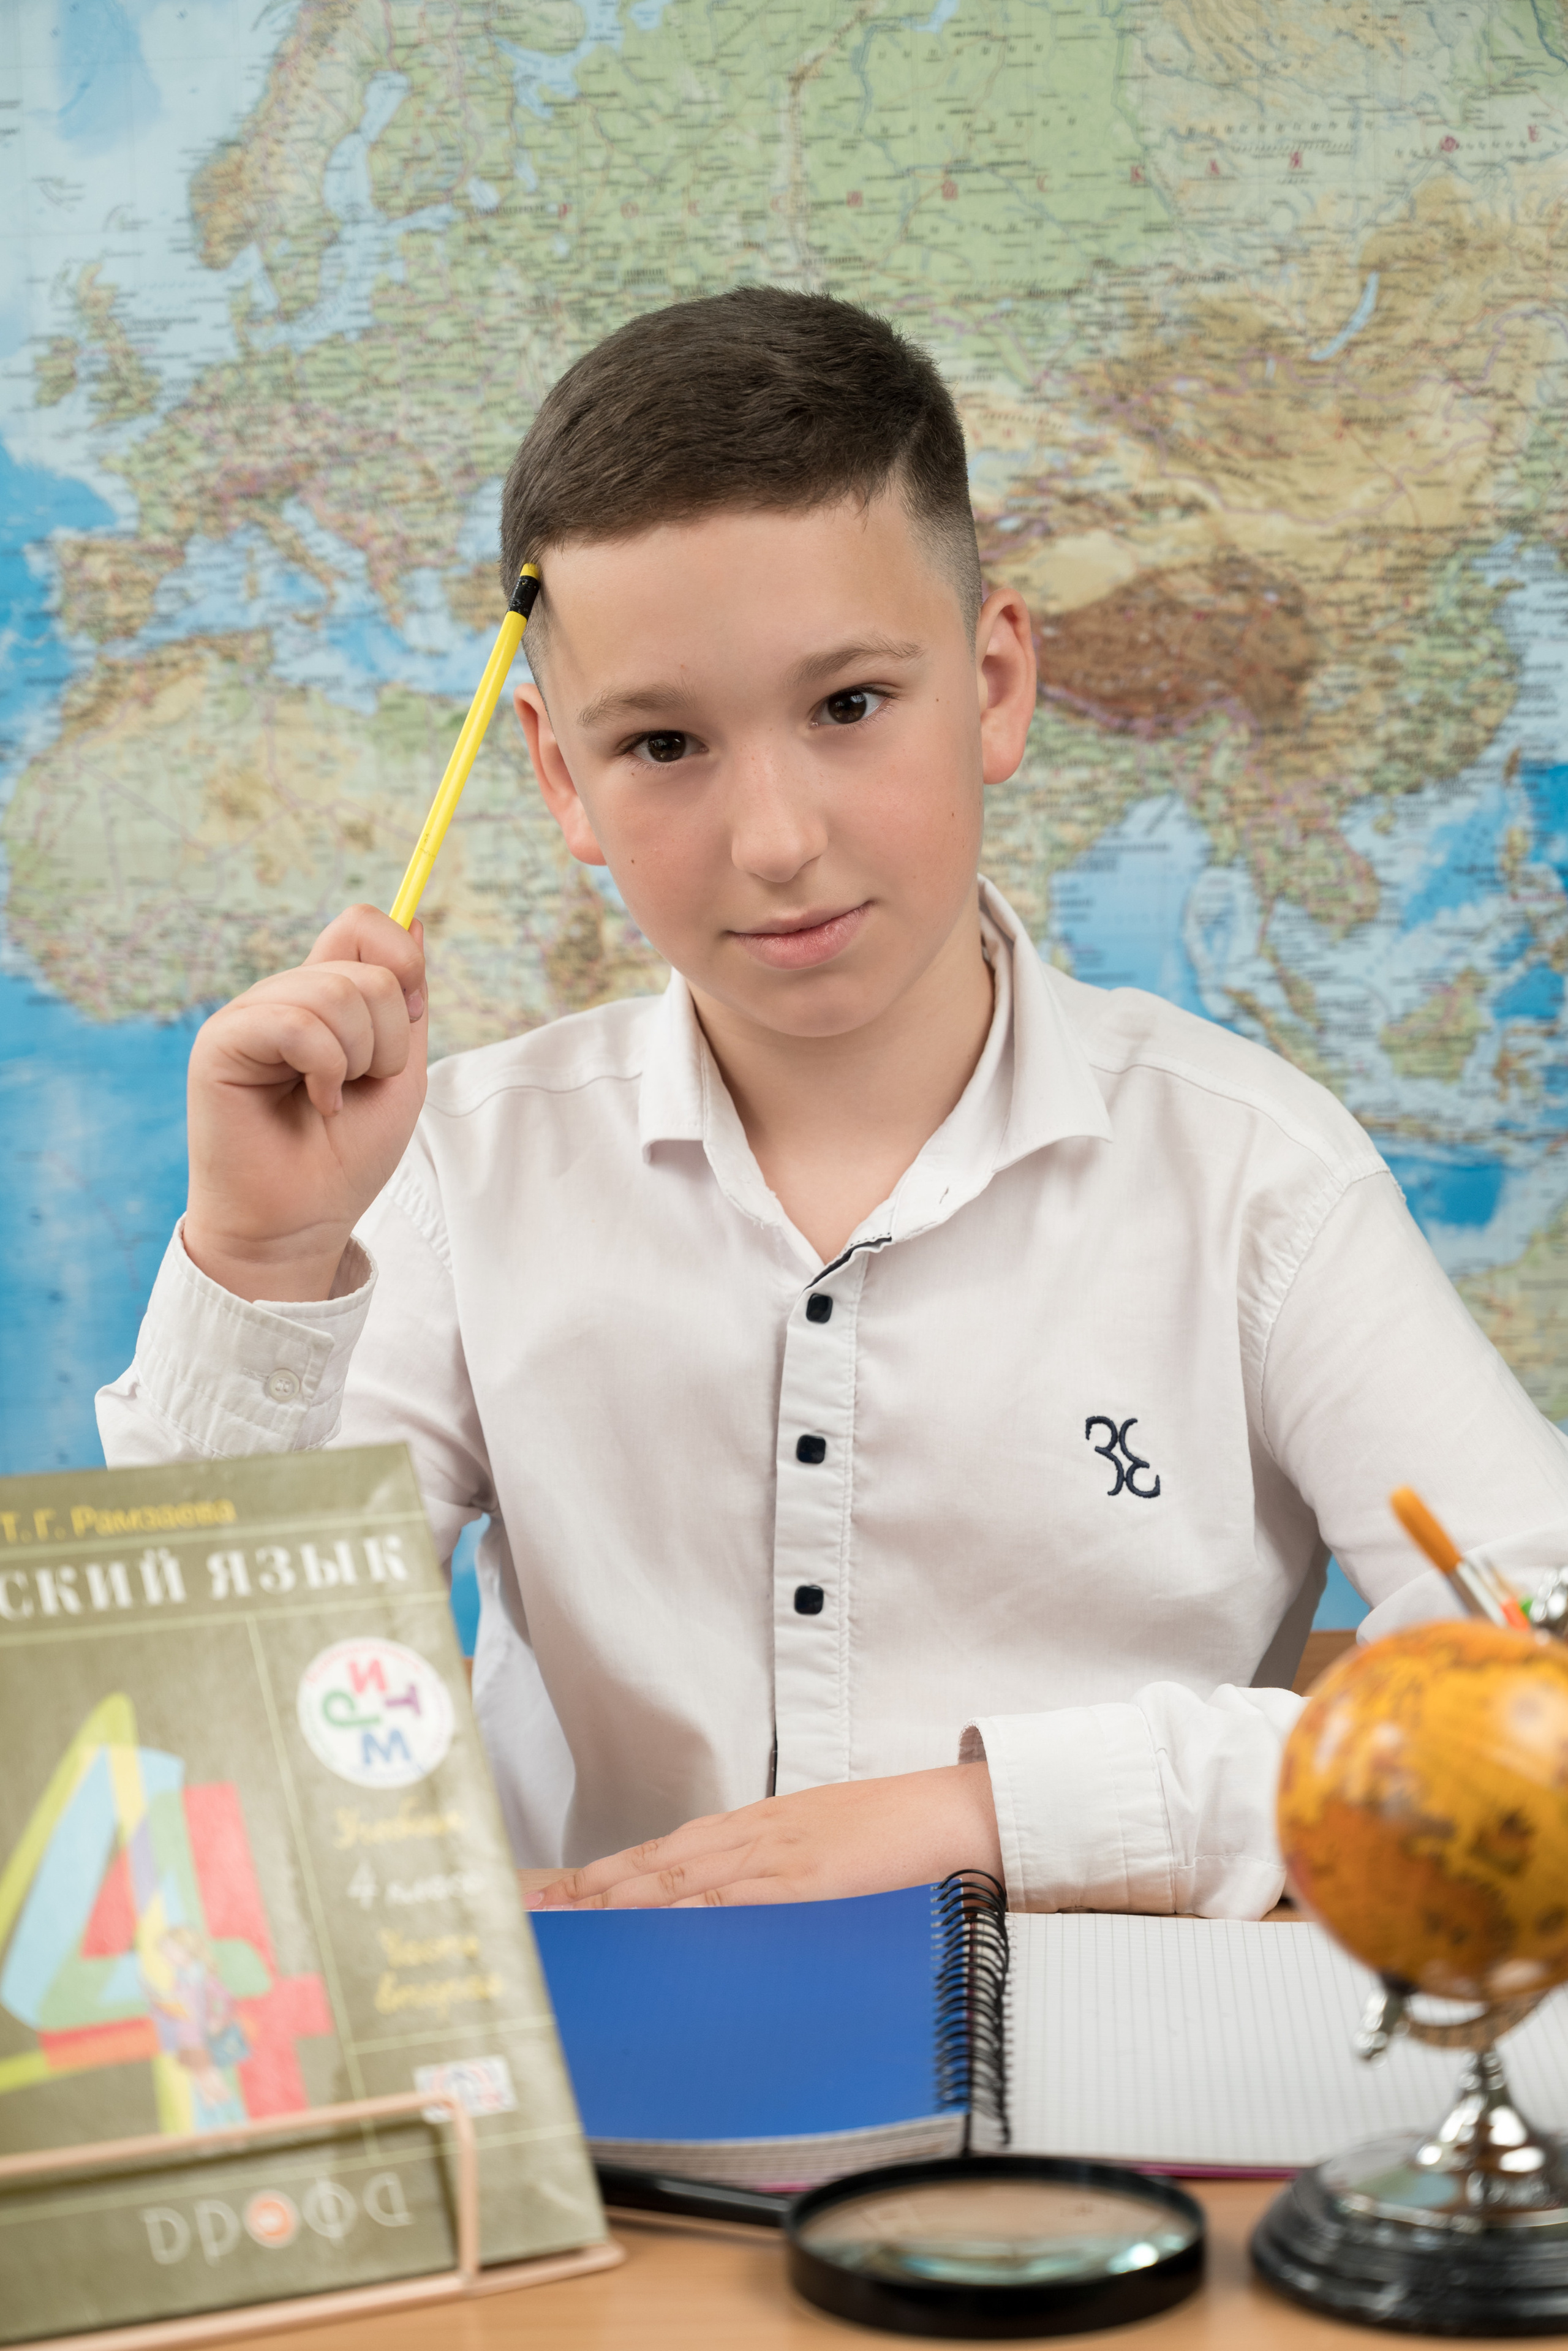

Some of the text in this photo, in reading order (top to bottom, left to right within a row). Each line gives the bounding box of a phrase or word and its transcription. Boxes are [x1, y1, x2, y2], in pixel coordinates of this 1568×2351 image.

[1, 1498, 237, 1544] Т. Г. Рамзаева
[207, 1534, 408, 1601] ЯЗЫК
